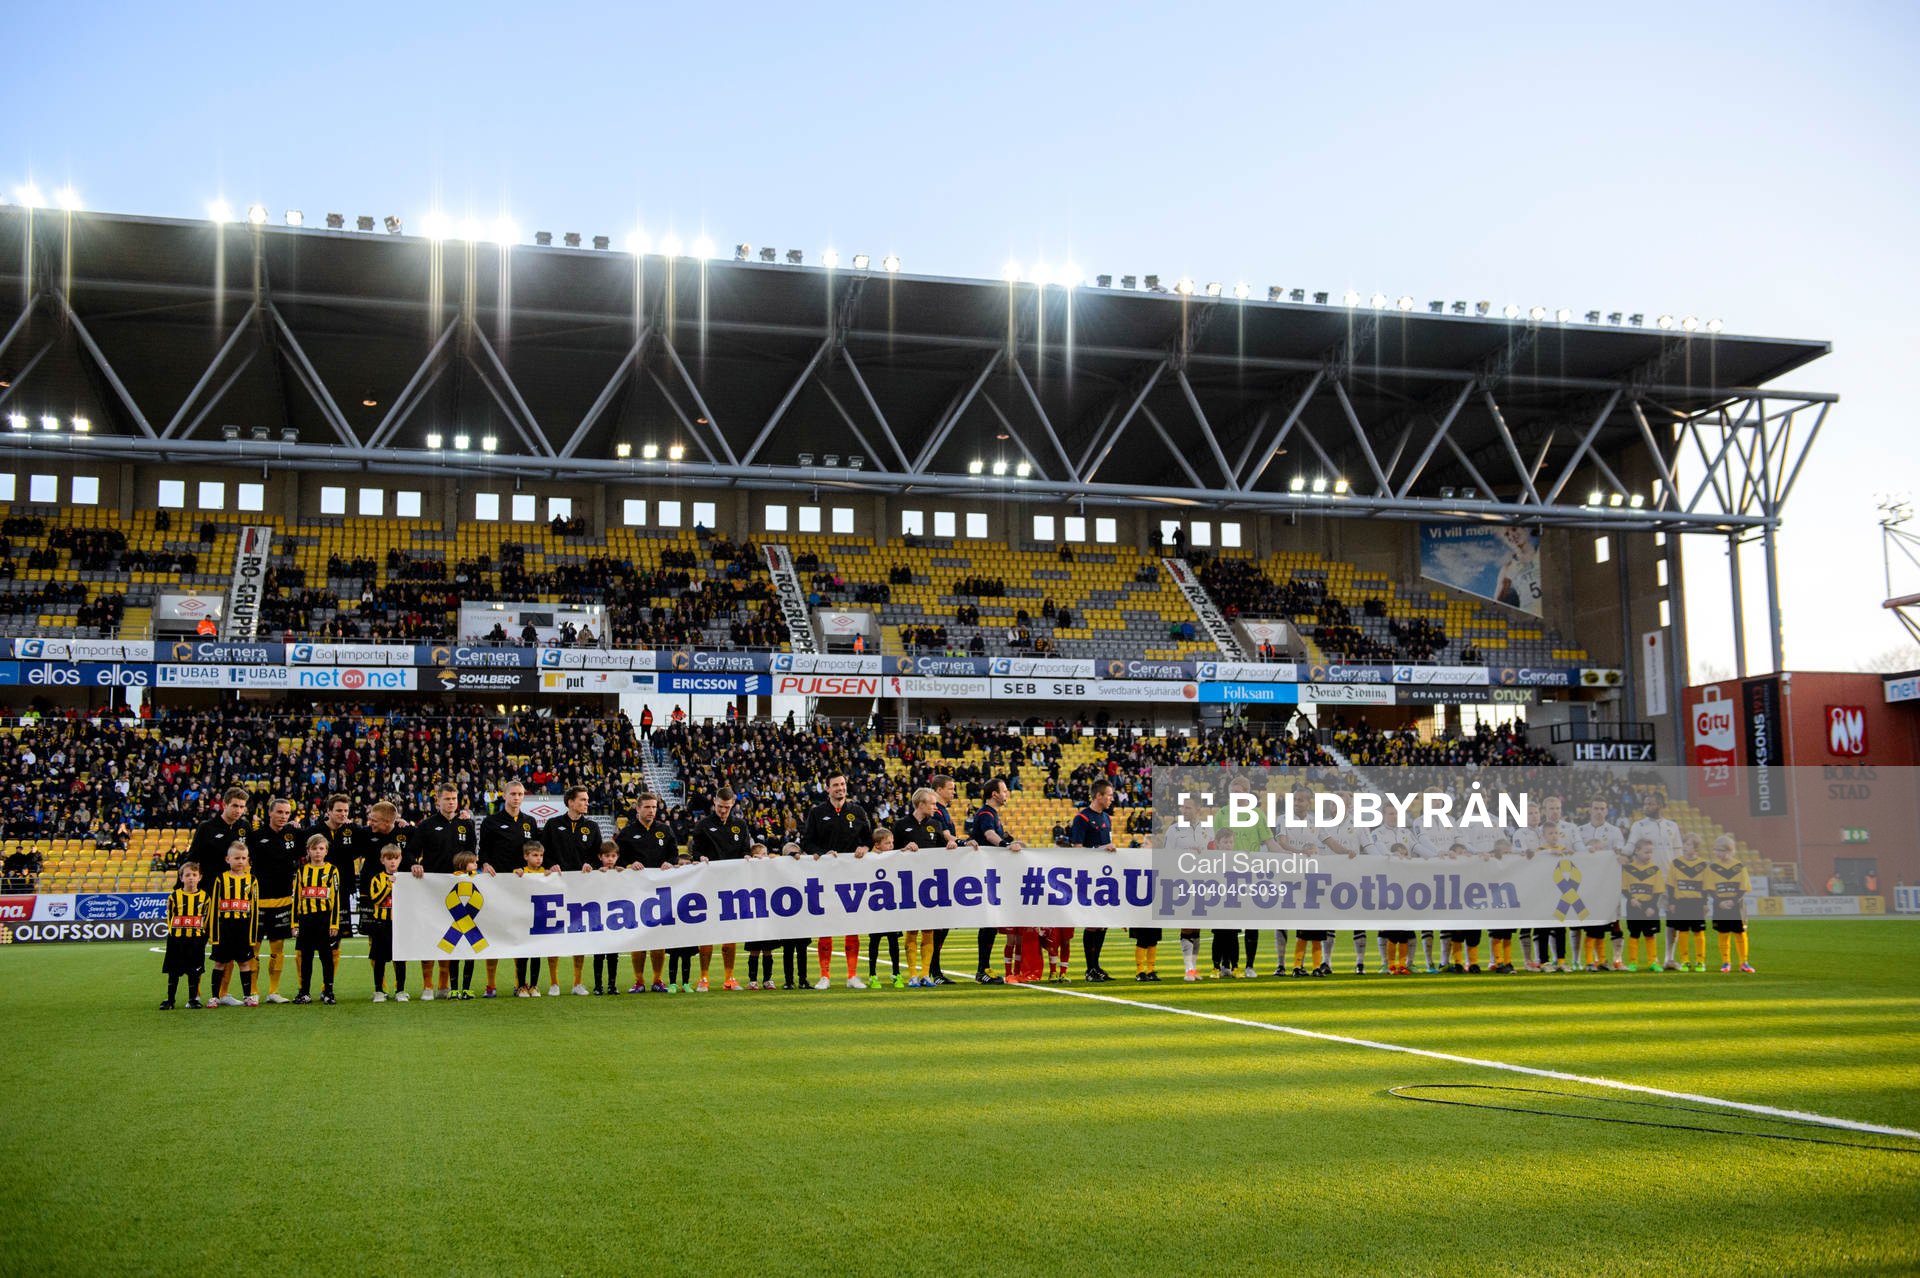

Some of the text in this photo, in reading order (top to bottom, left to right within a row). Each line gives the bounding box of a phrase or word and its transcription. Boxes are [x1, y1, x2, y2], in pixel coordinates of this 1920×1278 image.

[1445, 527, 1462, 537] vill
[198, 643, 268, 658] Cernera
[455, 648, 520, 662] Cernera
[693, 652, 754, 667] Cernera
[28, 662, 148, 686] ellos ellos
[181, 667, 287, 679] UBAB UBAB
[459, 674, 521, 685] SOHLBERG
[672, 678, 737, 690] ERICSSON
[779, 677, 878, 695] PULSEN
[905, 679, 985, 696] Riksbyggen
[1003, 683, 1086, 695] SEB SEB
[1098, 685, 1141, 696] Swedbank
[1223, 685, 1275, 699] Folksam
[1306, 685, 1342, 699] Borås
[1412, 691, 1488, 699] GRAND HOTEL
[1493, 689, 1533, 702] onyx
[1575, 743, 1652, 760] HEMTEX
[1828, 784, 1871, 800] STAD
[529, 864, 1521, 936] Enade mot våldet #StåUppFörFotbollen
[139, 907, 159, 919] och
[16, 923, 124, 941] OLOFSSON
